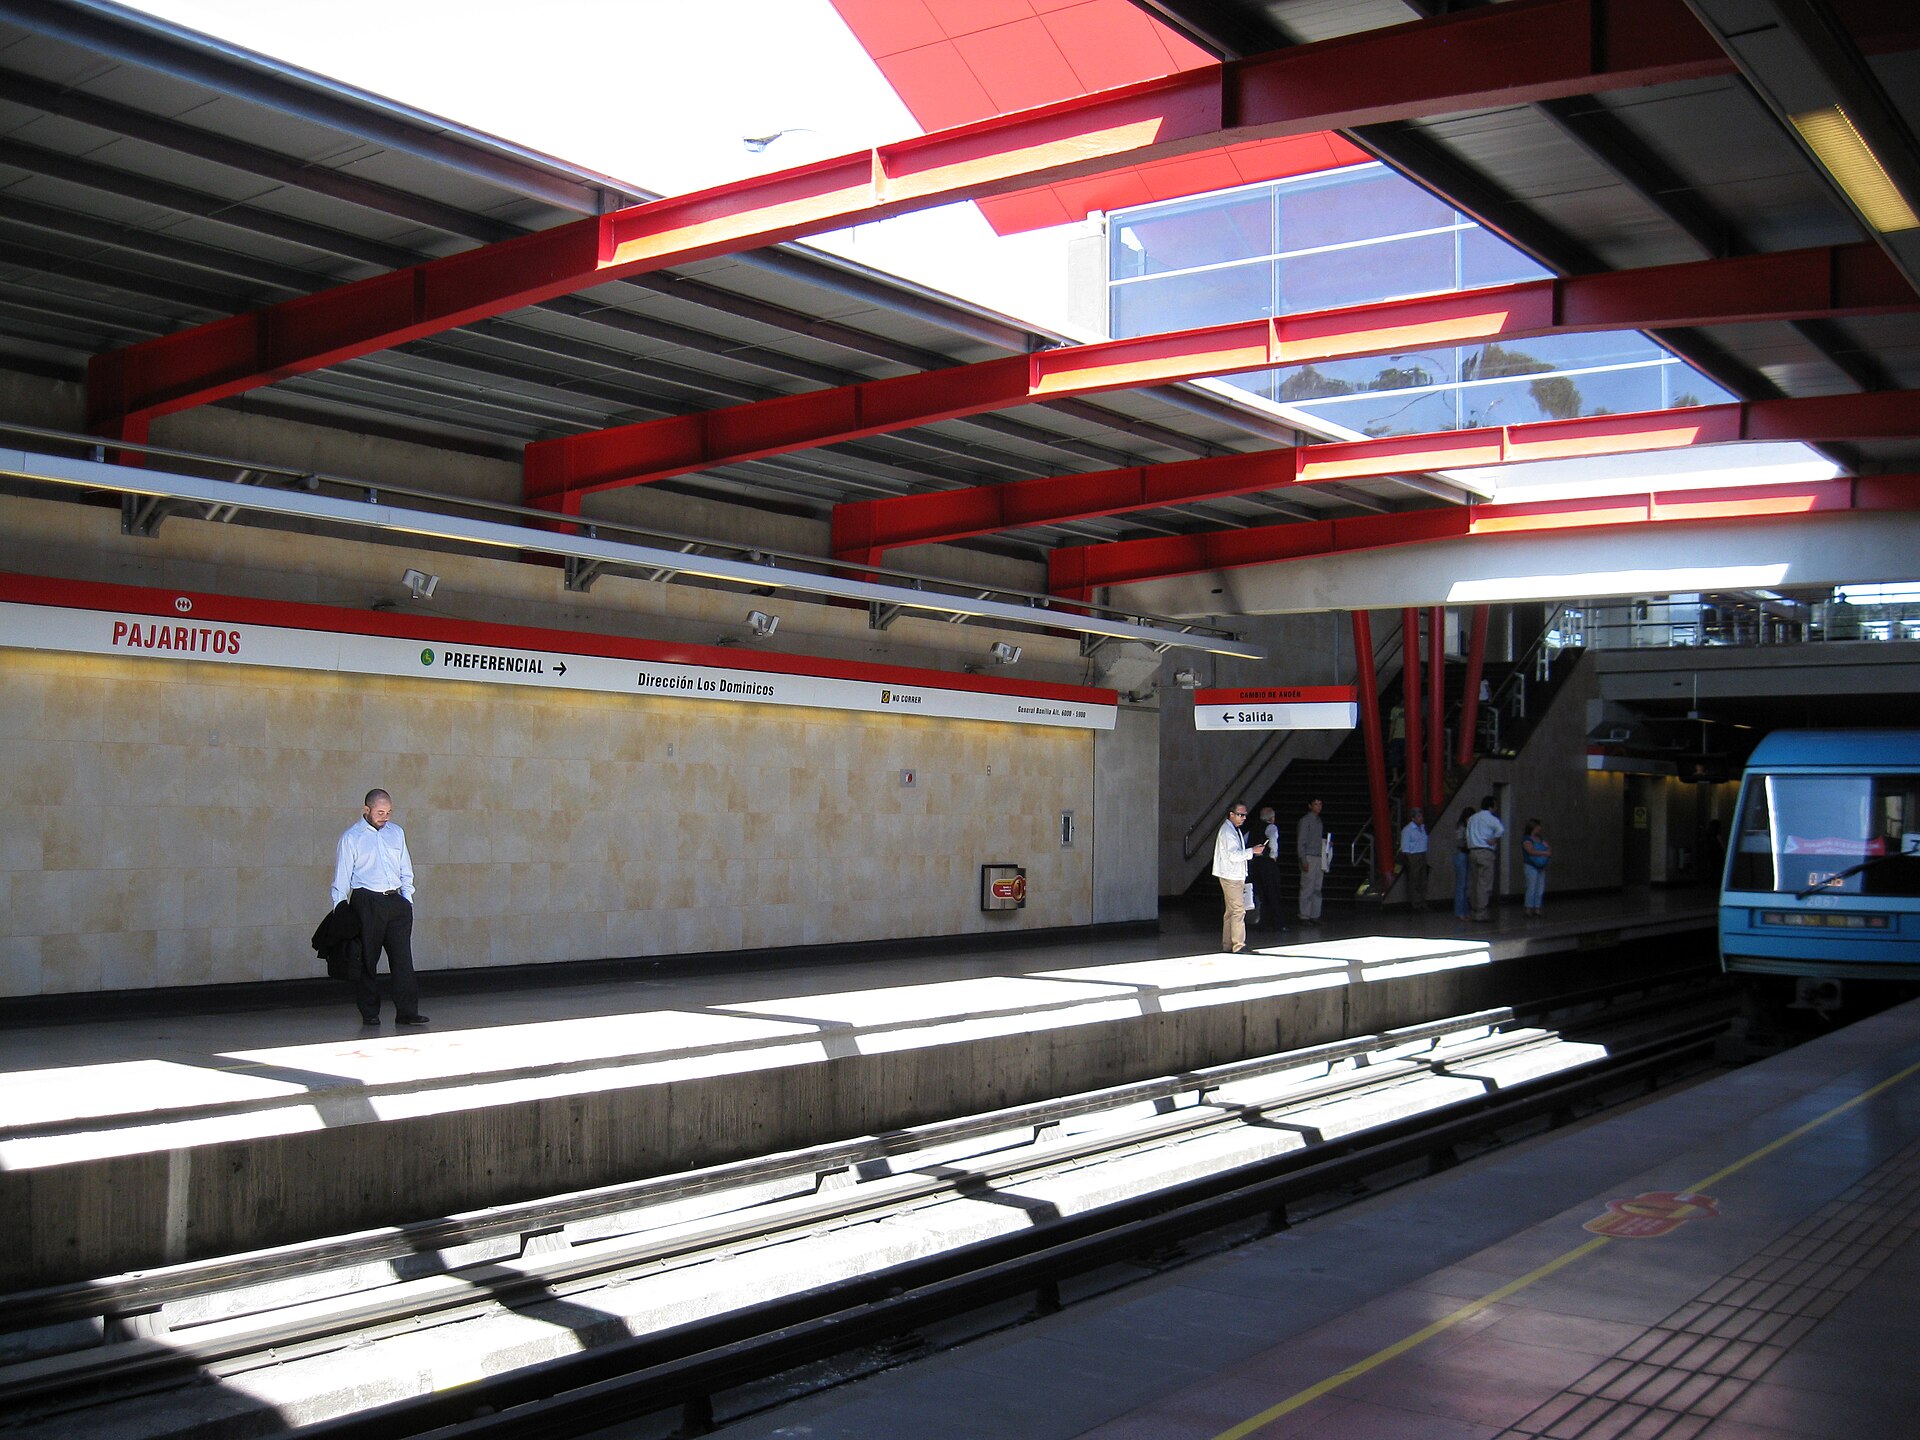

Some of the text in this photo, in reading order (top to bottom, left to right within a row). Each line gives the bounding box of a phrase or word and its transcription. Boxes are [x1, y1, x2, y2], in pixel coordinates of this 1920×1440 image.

[112, 621, 241, 654] PAJARITOS
[444, 651, 544, 674] PREFERENCIAL
[637, 672, 775, 696] Dirección Los Dominicos
[892, 694, 922, 704] NO CORRER
[1240, 691, 1266, 699] CAMBIO
[1238, 711, 1274, 723] Salida
